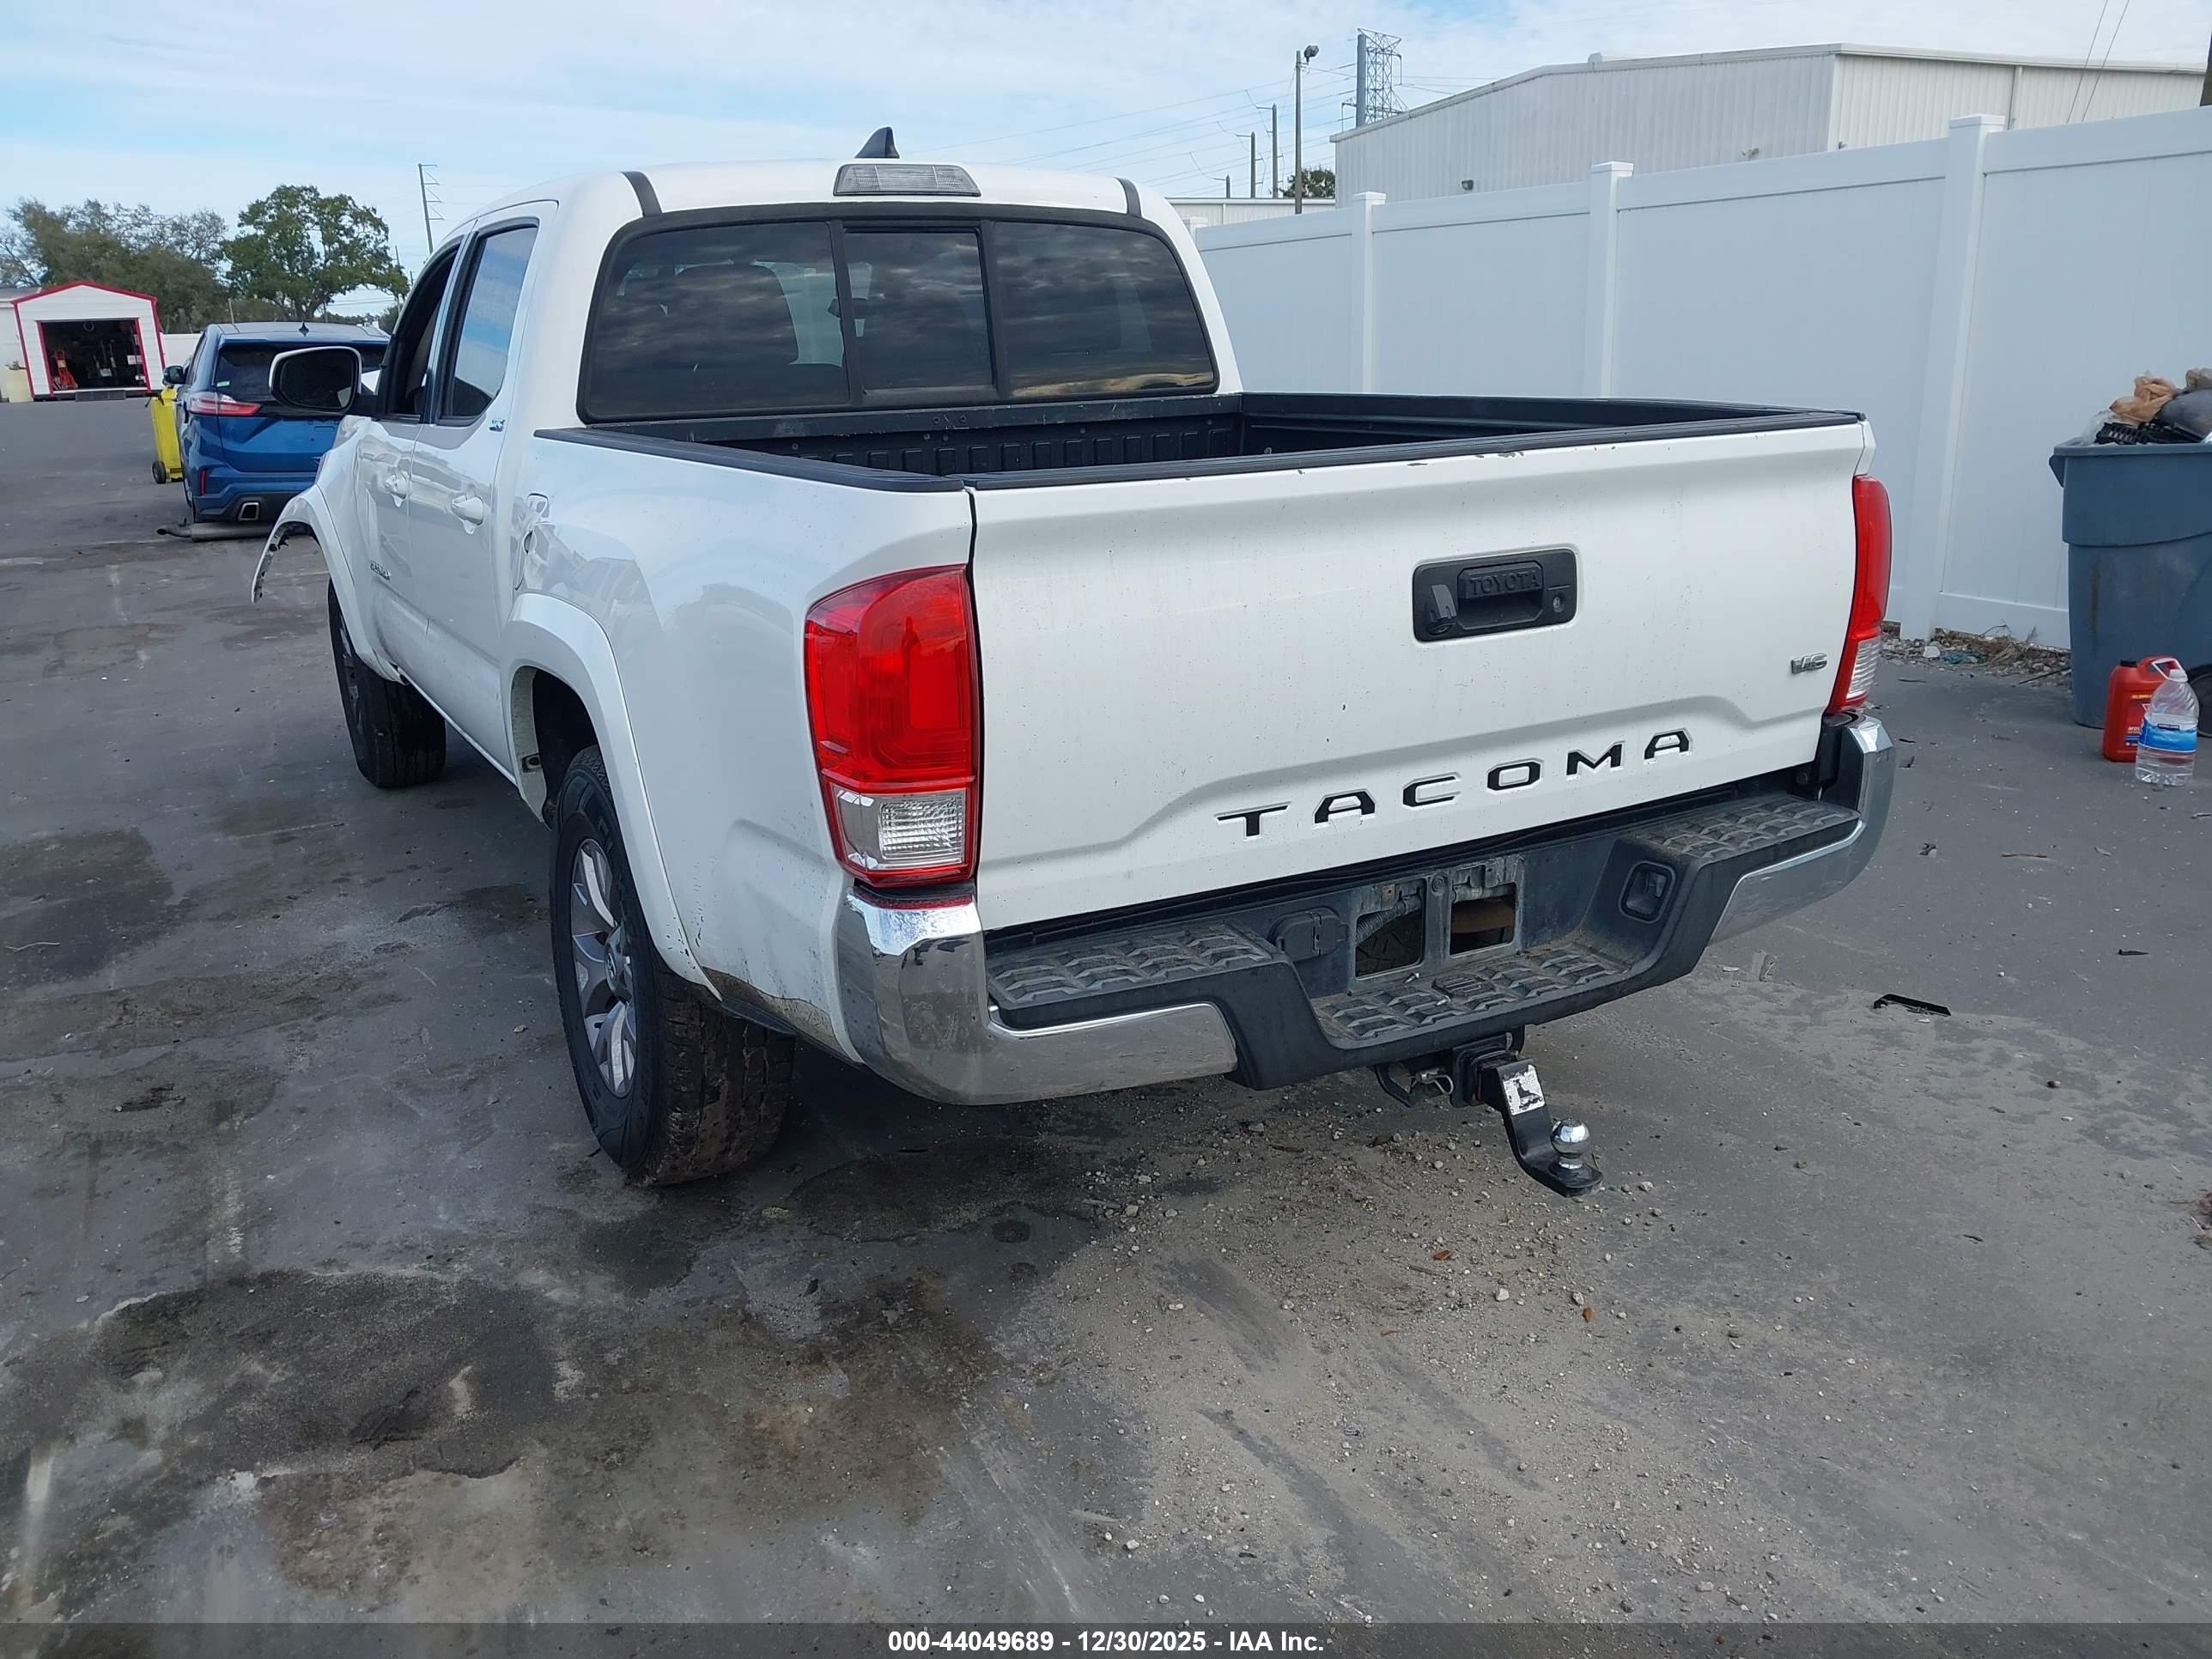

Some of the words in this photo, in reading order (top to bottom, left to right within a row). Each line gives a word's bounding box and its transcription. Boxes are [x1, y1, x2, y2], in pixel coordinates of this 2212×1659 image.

[1469, 570, 1541, 596] TOYOTA
[1790, 653, 1828, 674] V6
[1215, 727, 1692, 840] TACOMA
